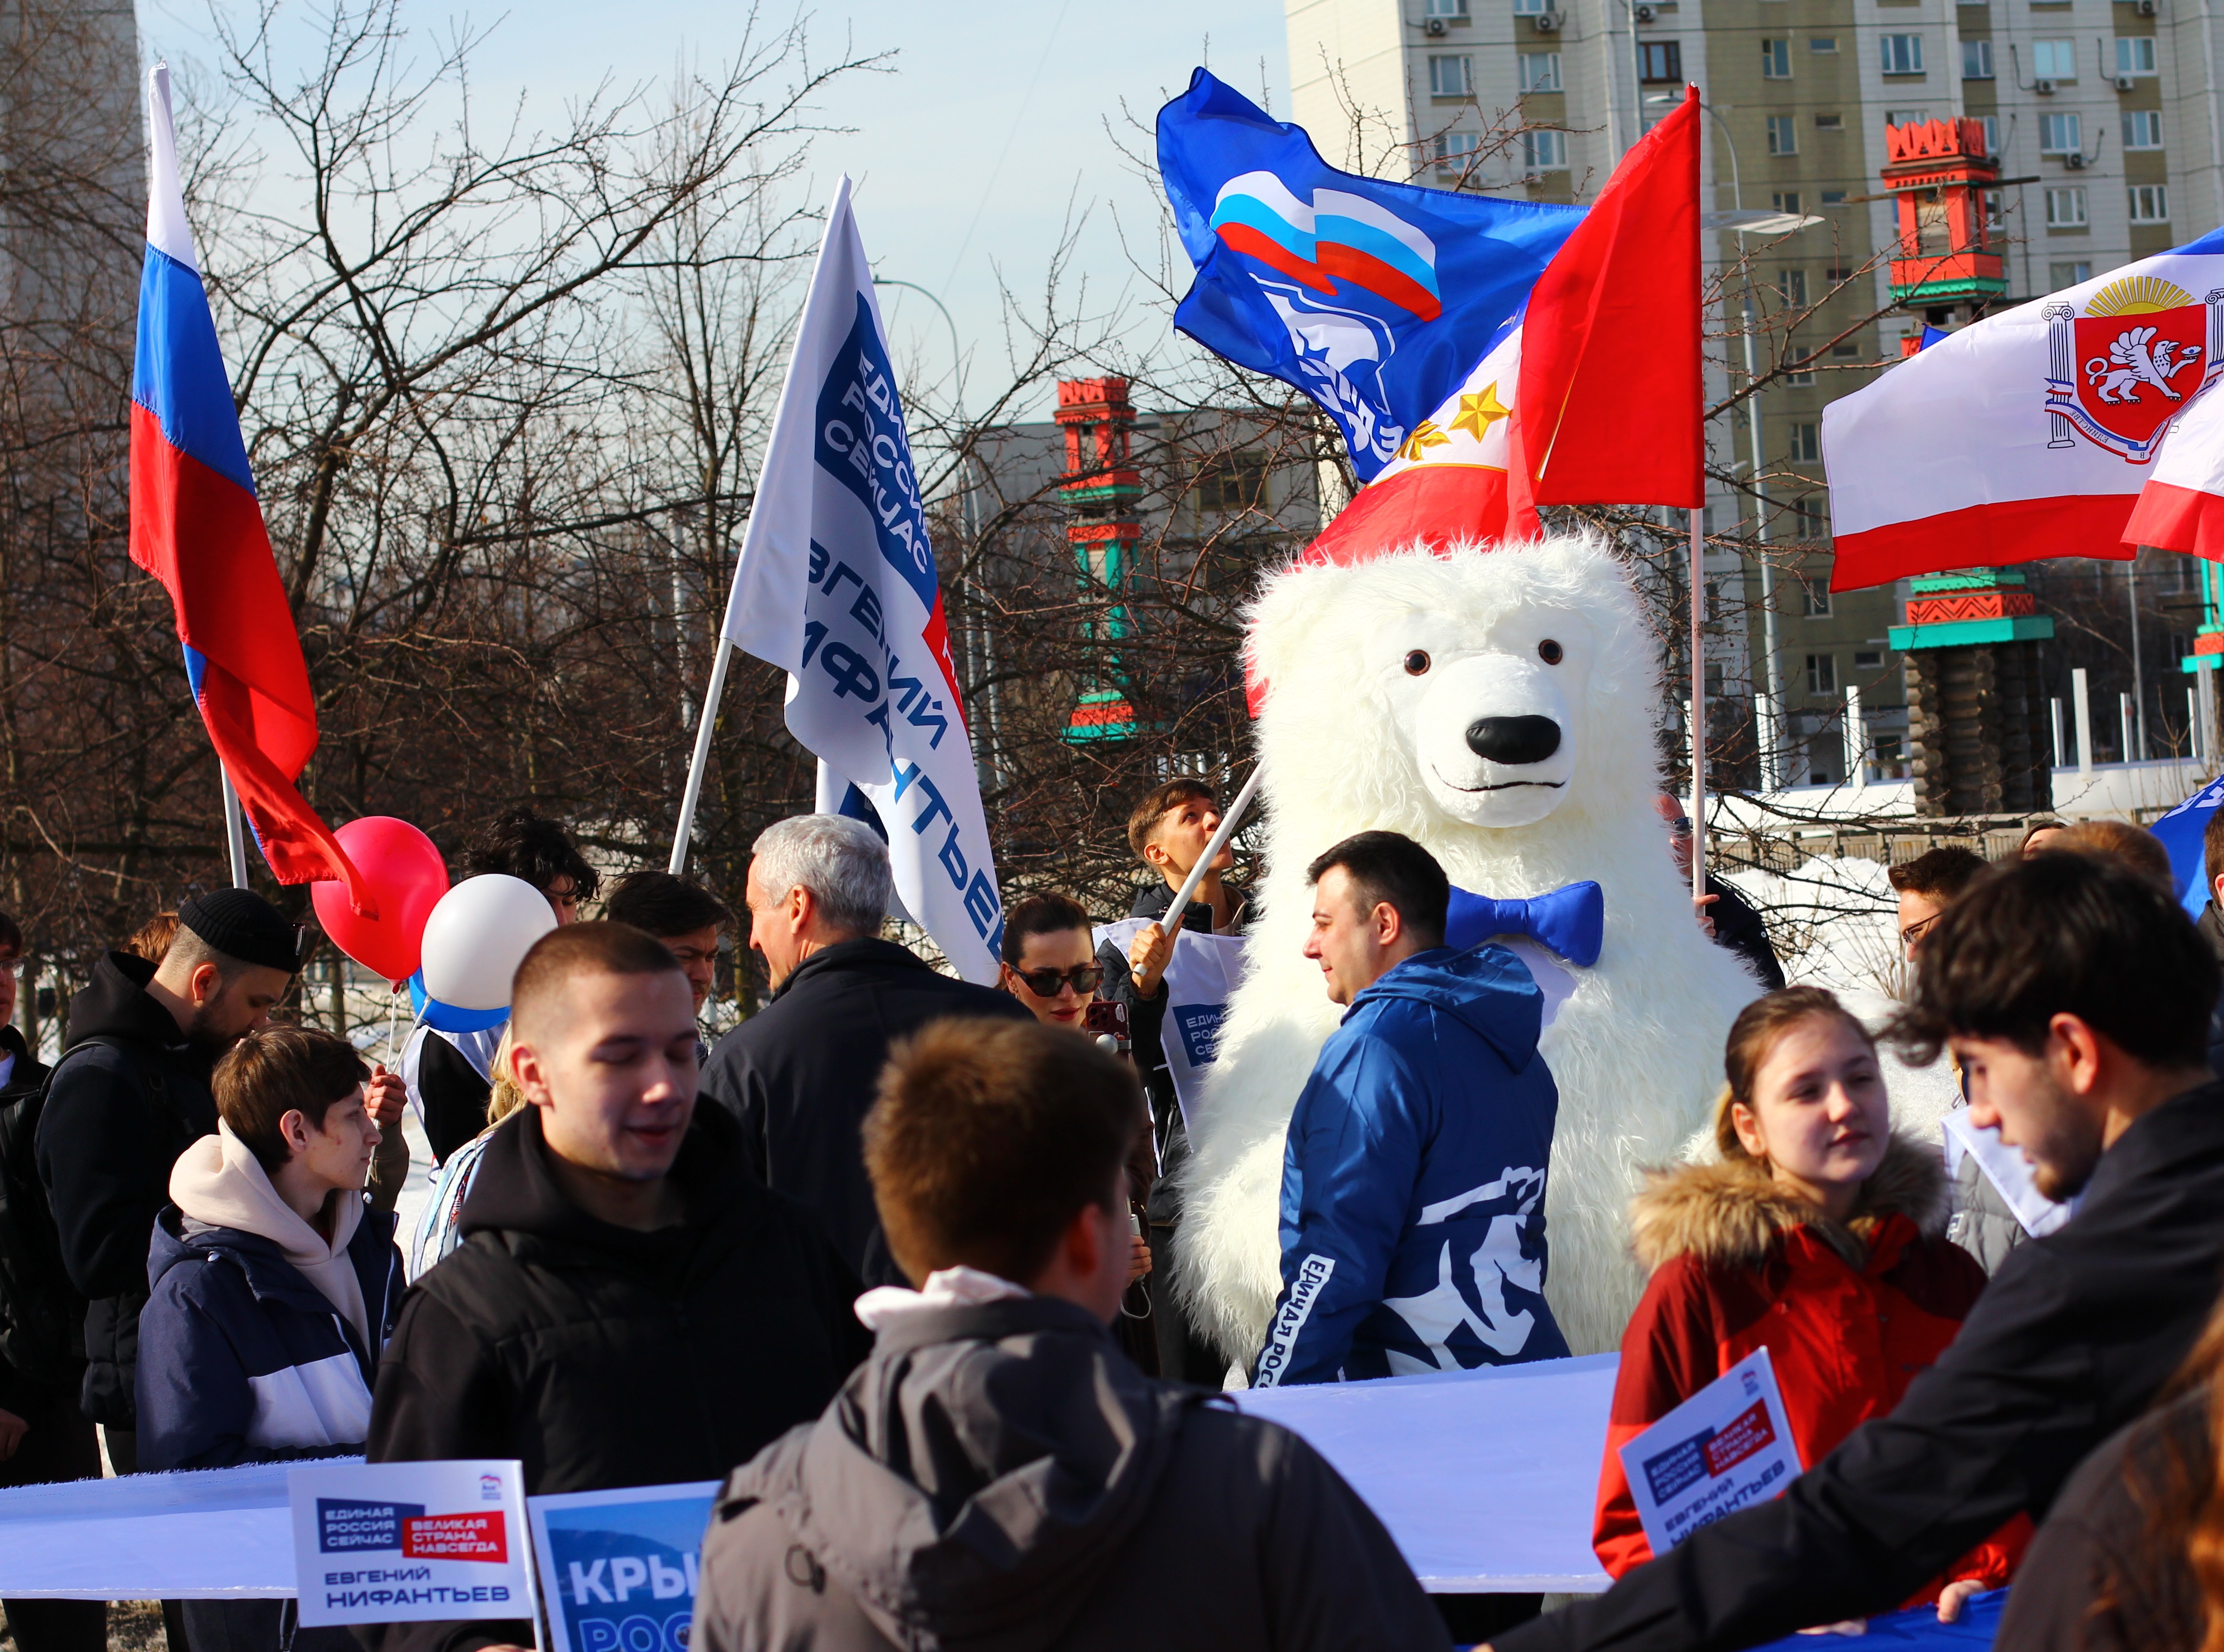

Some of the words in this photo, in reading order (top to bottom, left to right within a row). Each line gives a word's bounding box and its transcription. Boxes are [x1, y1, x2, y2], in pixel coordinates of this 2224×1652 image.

[825, 420, 928, 574] СЕЙЧАС
[1277, 1260, 1326, 1337] ЕДИНАЯ
[325, 1507, 395, 1521] ЕДИНАЯ
[1665, 1477, 1735, 1532] ЕВГЕНИЙ
[326, 1520, 395, 1533] РОССИЯ
[411, 1519, 487, 1531] ВЕЛИКАЯ
[327, 1532, 393, 1547] СЕЙЧАС
[411, 1531, 478, 1543] СТРАНА
[413, 1541, 499, 1554] НАВСЕГДА
[325, 1565, 431, 1585] ЕВГЕНИЙ
[568, 1552, 700, 1606] КРЫ
[326, 1587, 510, 1609] НИФАНТЬЕВ
[578, 1611, 692, 1652] РОС
